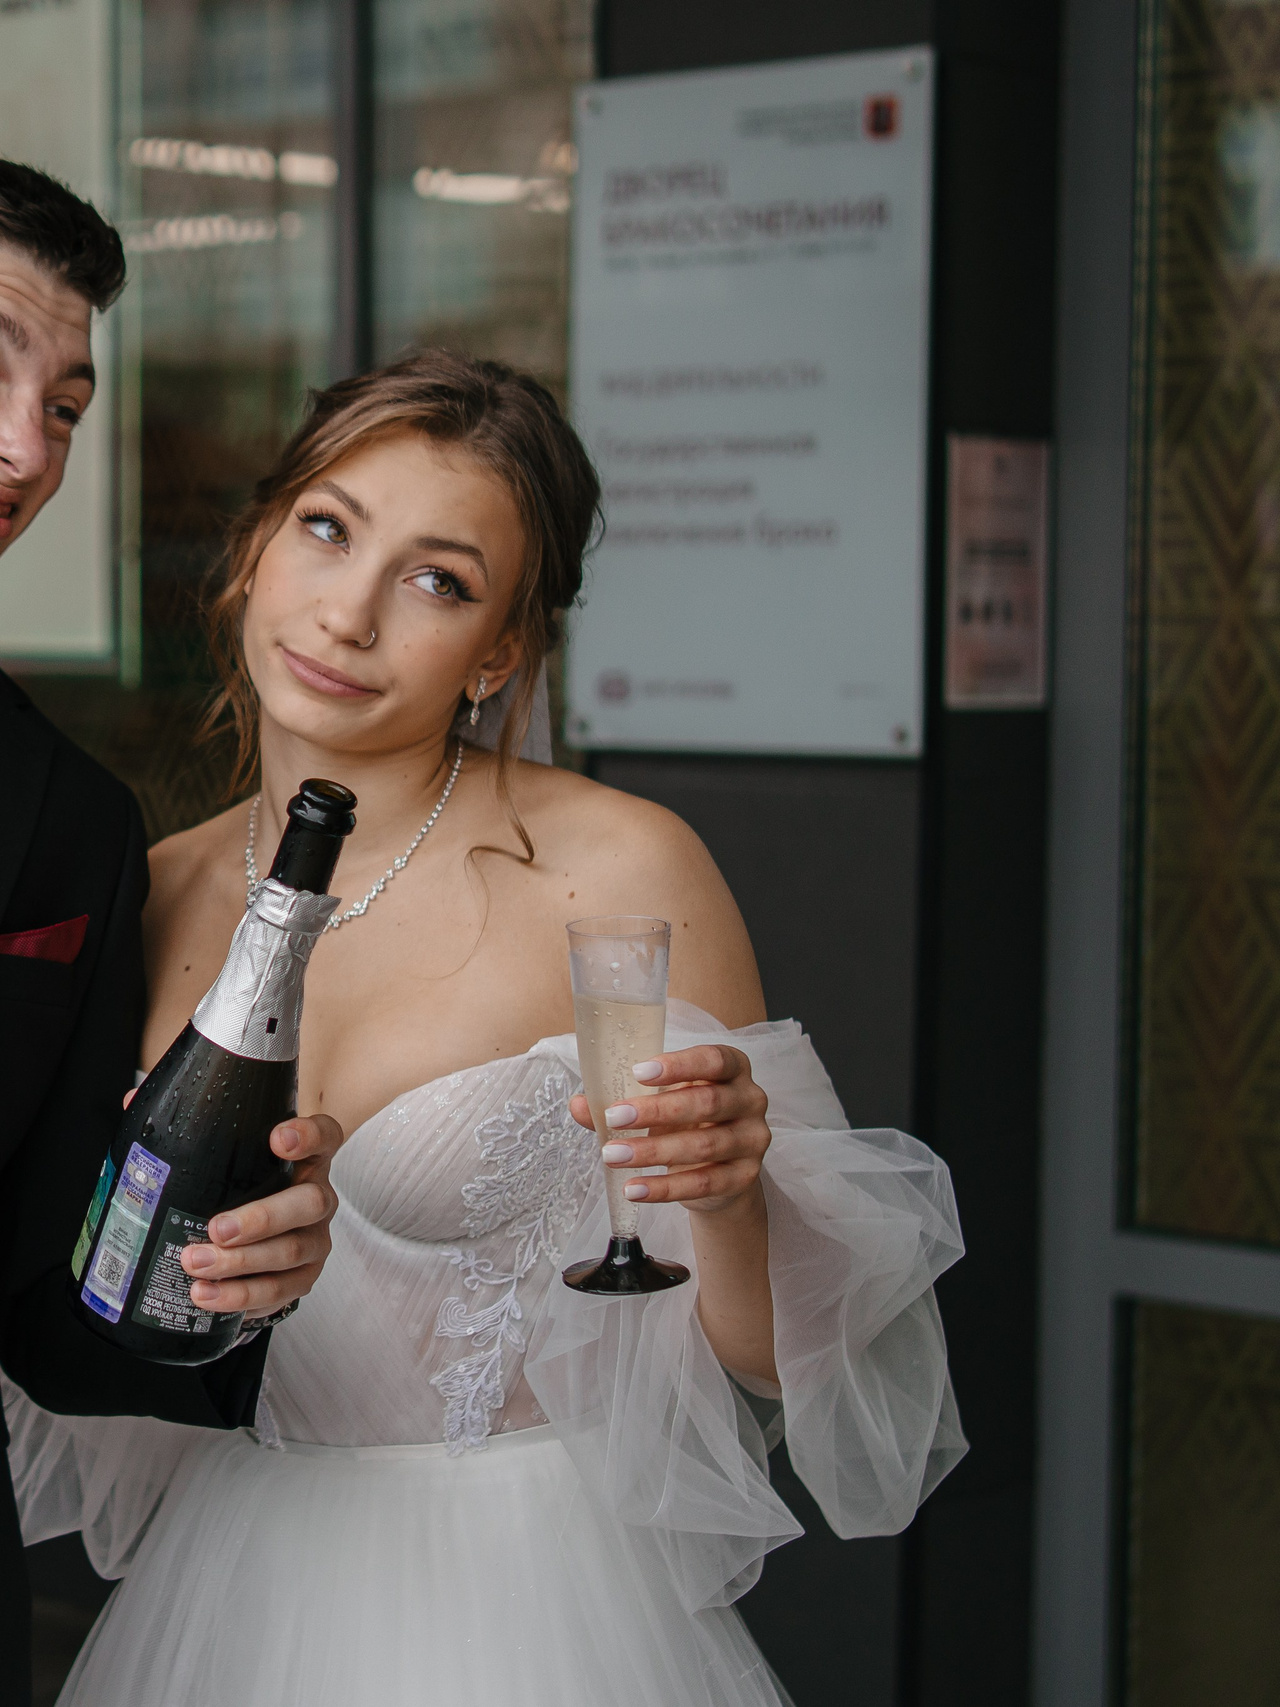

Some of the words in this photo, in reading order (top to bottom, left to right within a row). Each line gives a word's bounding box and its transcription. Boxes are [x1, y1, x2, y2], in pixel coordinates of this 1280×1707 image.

[131, 1155, 161, 1179] ФЕДЕРАЦИЯ
[132, 1150, 163, 1174] РОССИЙСКАЯ
[126, 1190, 142, 1204] МАРКА
[184, 1219, 195, 1228] DI
[196, 1223, 209, 1231] CA
[140, 1304, 151, 1315] ГОД
